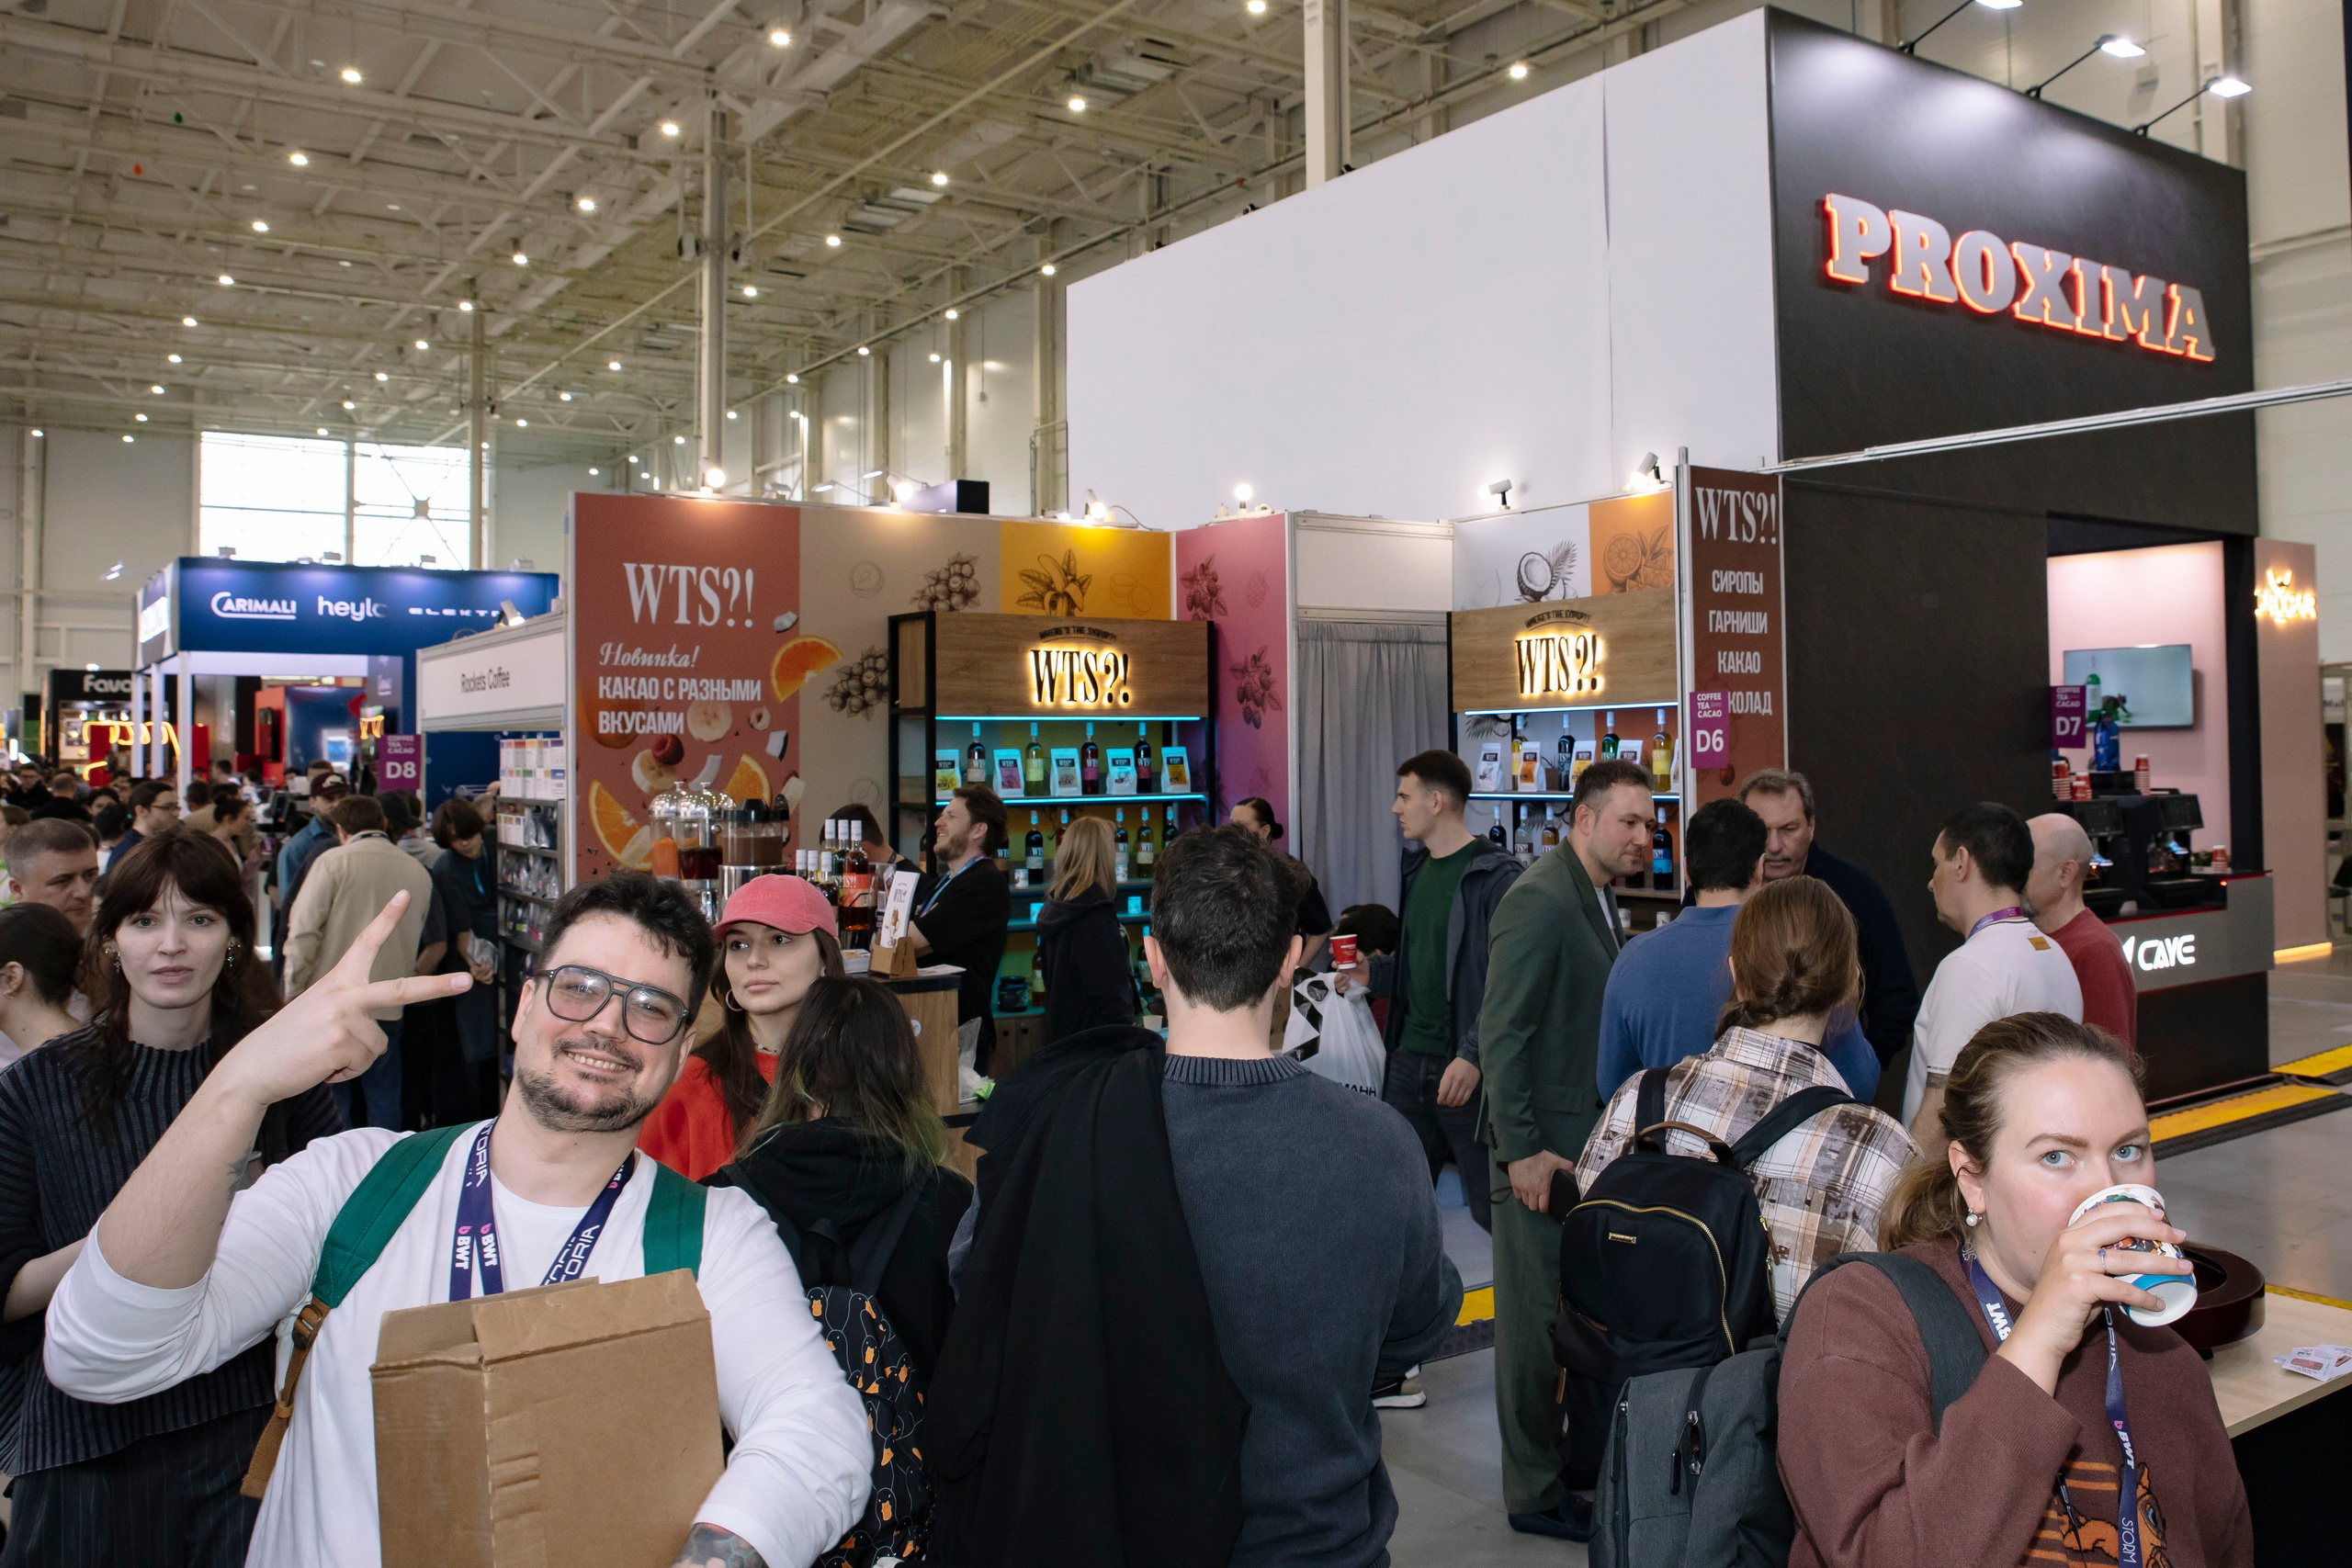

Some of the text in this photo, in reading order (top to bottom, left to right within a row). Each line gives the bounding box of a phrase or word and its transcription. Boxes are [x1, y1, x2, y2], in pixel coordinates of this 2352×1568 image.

[1825, 191, 2216, 362] PROXIMA
[1694, 486, 1778, 545] WTS?!
[1712, 570, 1763, 594] СИРОПЫ
[210, 591, 297, 620] CARIMALI
[623, 562, 754, 628] WTS?!
[408, 607, 522, 618] ELEKTR
[1709, 610, 1768, 634] ГАРНИШИ
[599, 642, 700, 668] Новинка!
[1514, 634, 1598, 694] WTS?!
[1717, 650, 1760, 673] КАКАО
[598, 676, 762, 701] КАКАО С РАЗНЫМИ
[1030, 649, 1130, 704] WTS?!
[1696, 693, 1722, 701] COFFEE
[1728, 691, 1772, 716] КОЛАД
[598, 711, 684, 734] ВКУСАМИ
[1697, 710, 1723, 718] CACAO
[2055, 716, 2081, 736] D7
[1696, 728, 1724, 752] D6
[386, 761, 416, 779] D8
[475, 1122, 495, 1188] TORIA
[455, 1235, 471, 1269] BWT
[481, 1233, 499, 1268] BWT
[2118, 1430, 2134, 1470] BWT
[2121, 1517, 2137, 1563] STORM
